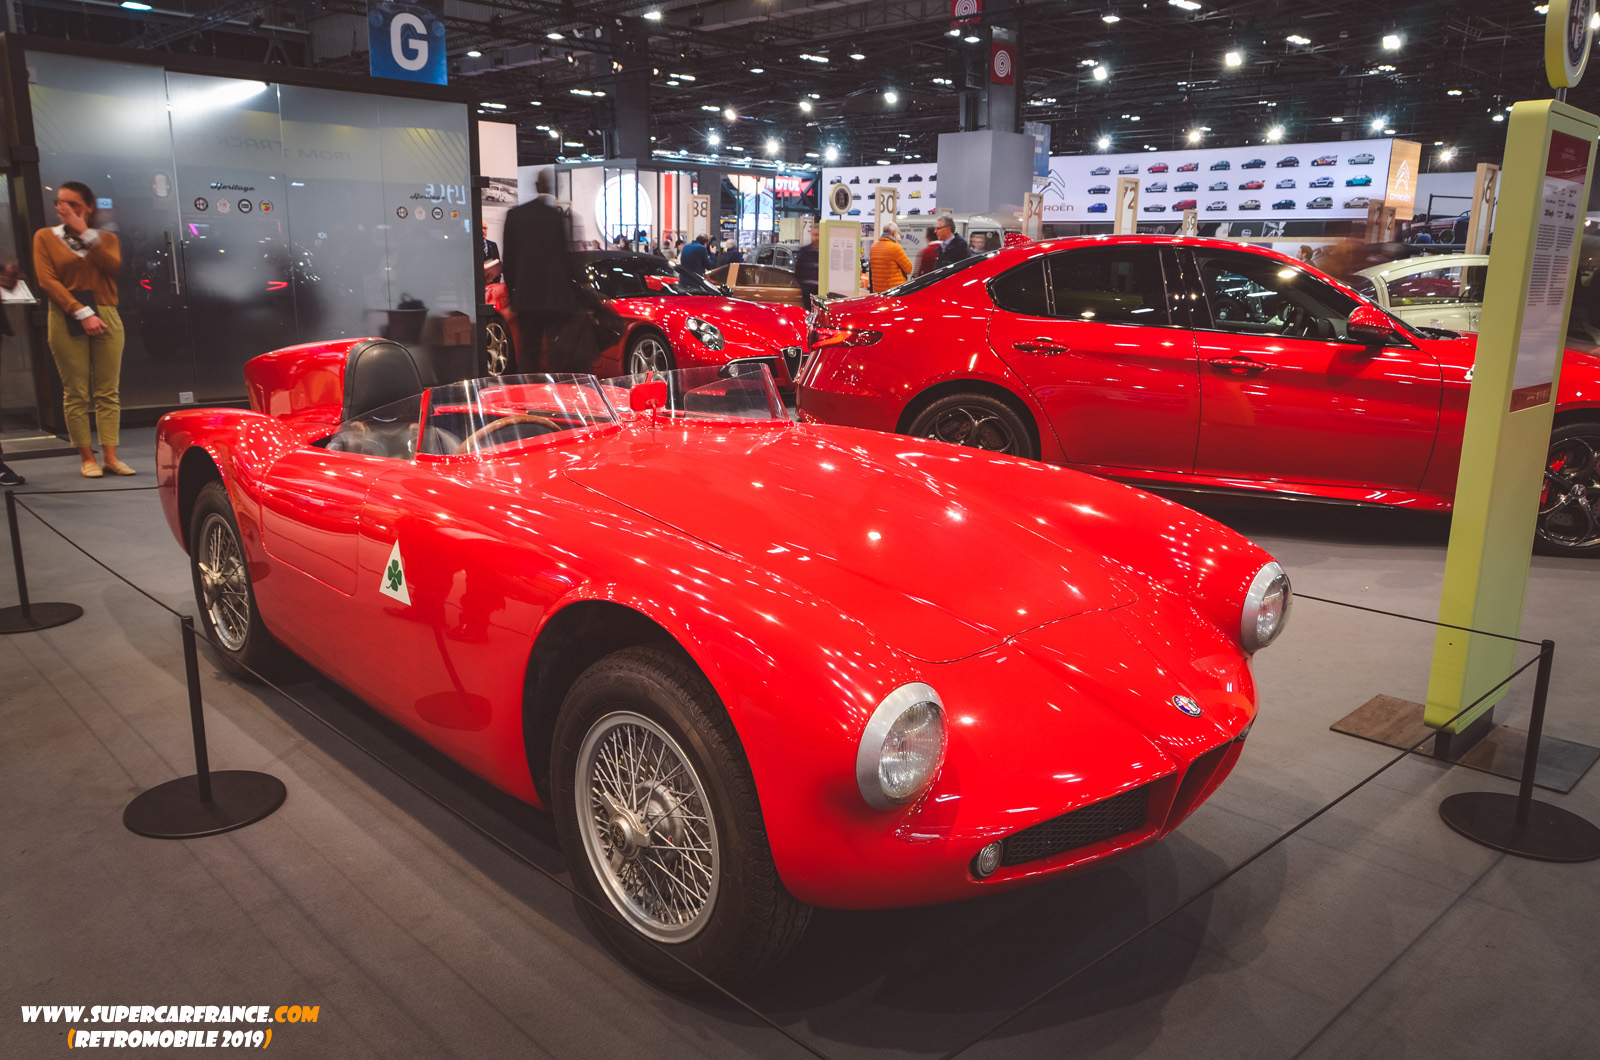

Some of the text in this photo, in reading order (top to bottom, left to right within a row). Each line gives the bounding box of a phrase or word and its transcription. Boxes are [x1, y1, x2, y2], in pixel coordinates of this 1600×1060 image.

[390, 12, 428, 71] G
[210, 181, 255, 192] Heritage
[766, 178, 801, 191] MOTUL
[410, 192, 446, 200] Heritage
